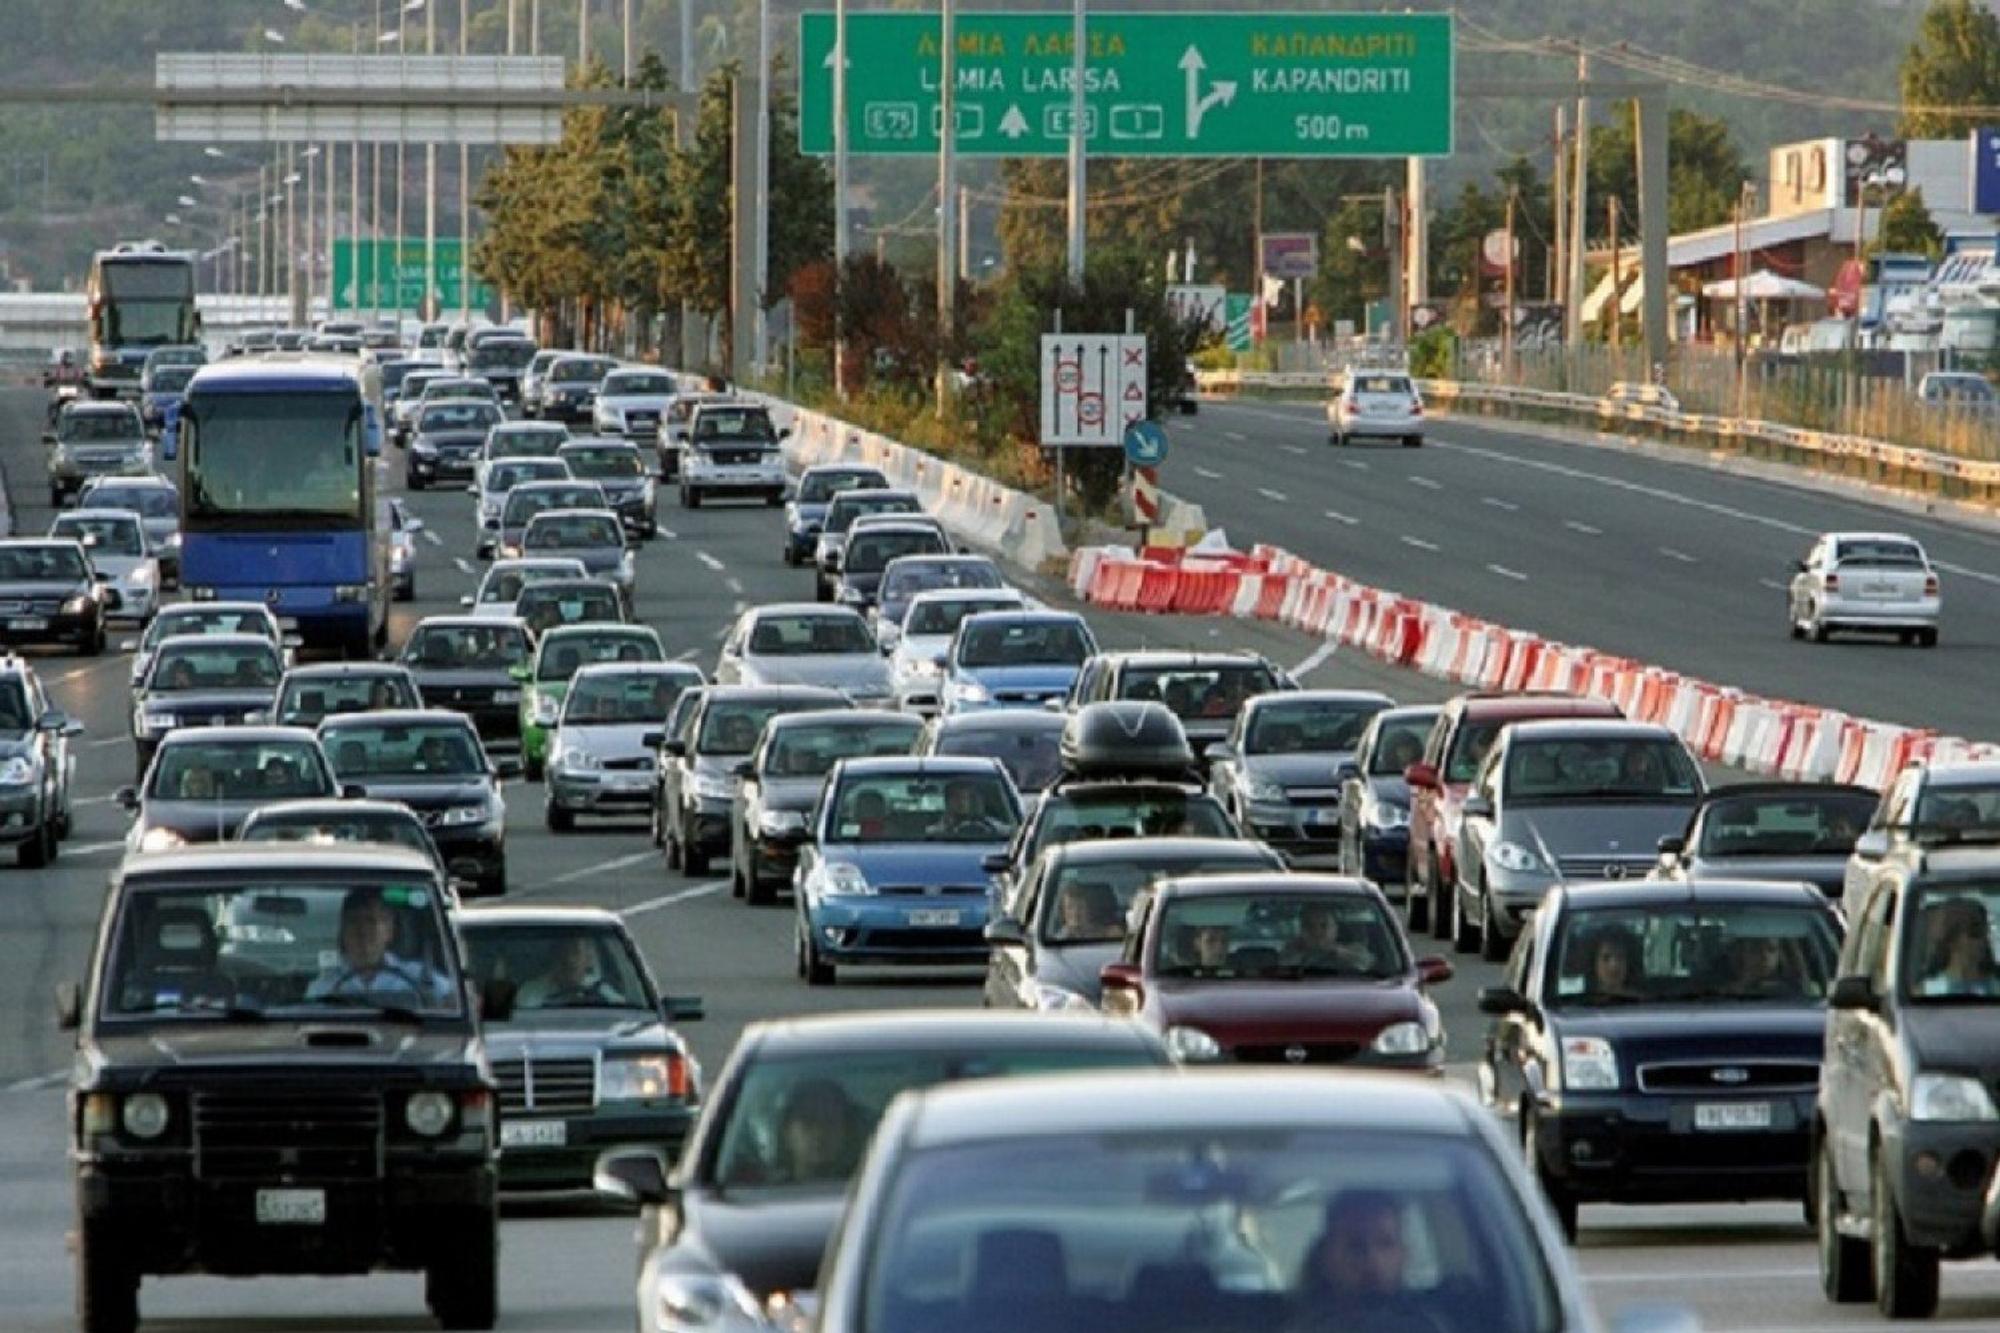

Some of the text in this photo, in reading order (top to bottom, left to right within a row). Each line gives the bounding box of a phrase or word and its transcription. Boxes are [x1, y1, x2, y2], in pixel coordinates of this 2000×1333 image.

[920, 66, 1121, 92] LMIA LARSA
[1252, 67, 1411, 93] KAPANDRITI
[1296, 114, 1369, 140] 500 m
